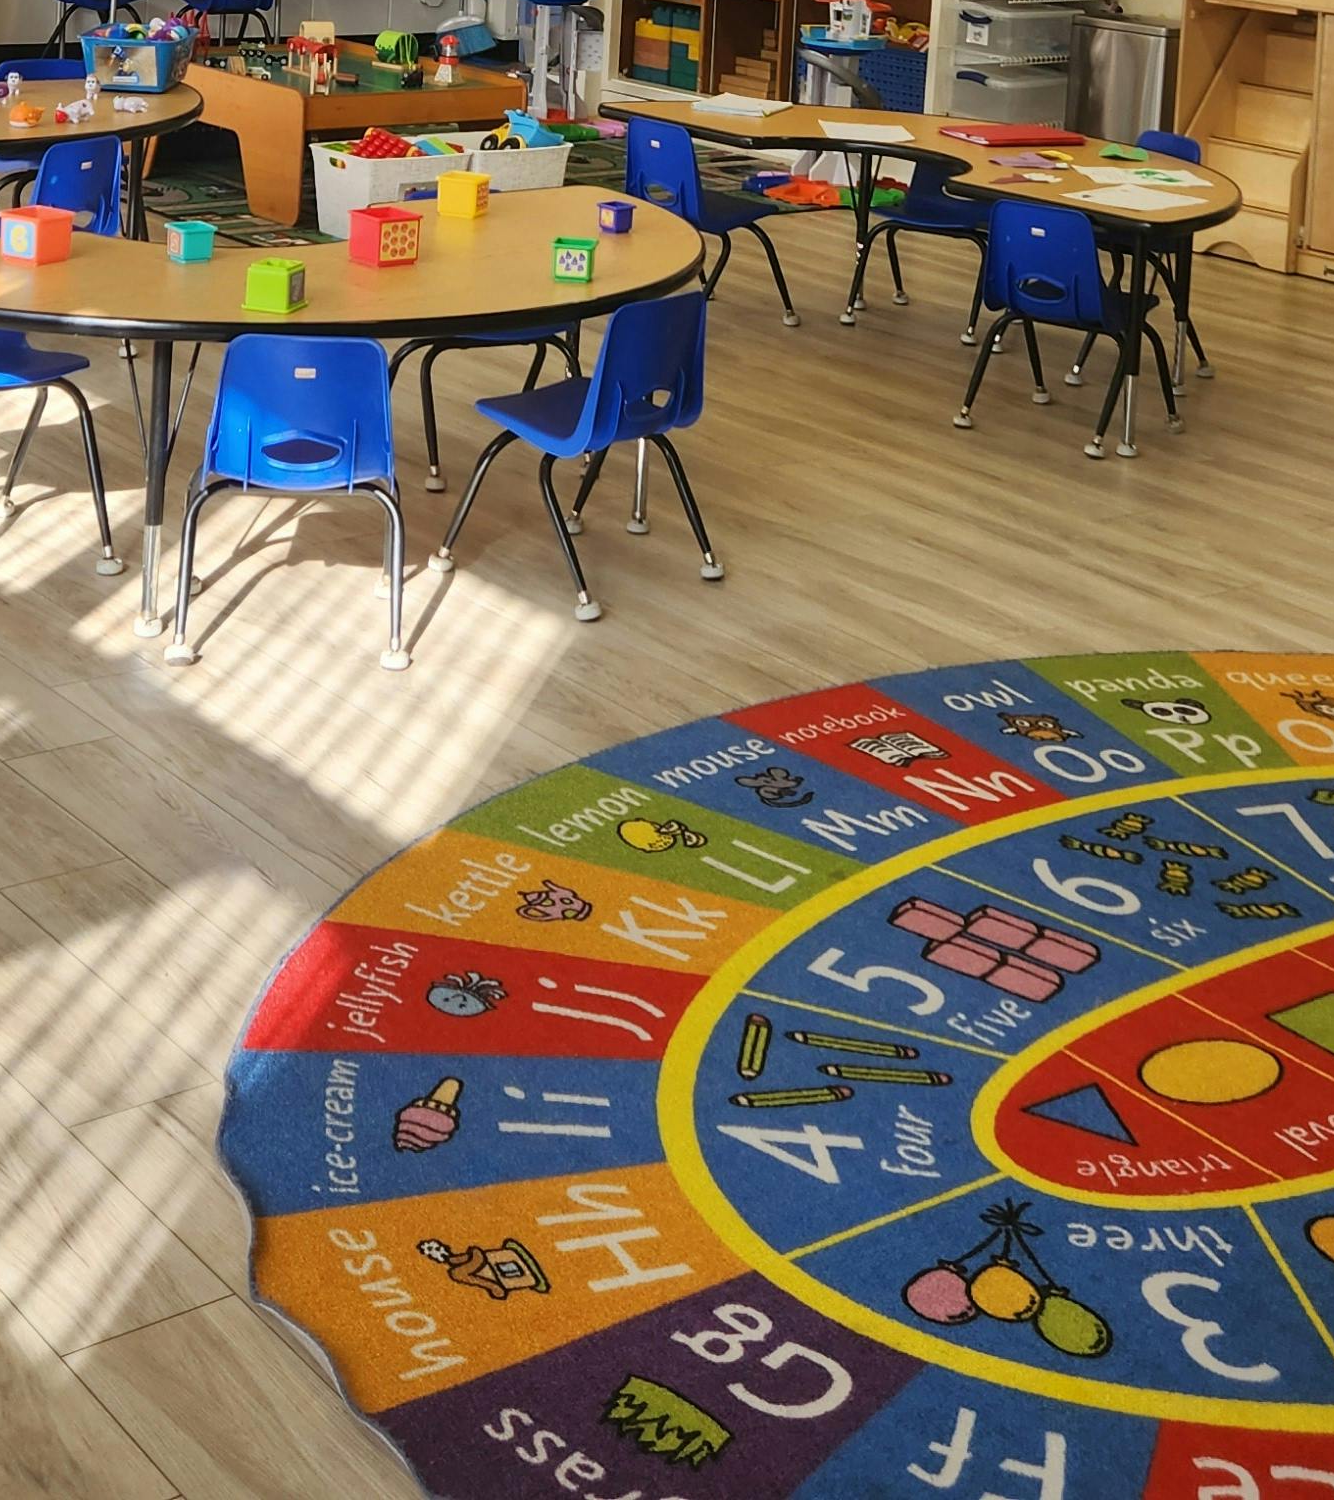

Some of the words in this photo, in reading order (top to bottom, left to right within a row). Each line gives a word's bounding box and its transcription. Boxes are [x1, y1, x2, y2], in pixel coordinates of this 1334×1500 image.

[942, 680, 1032, 714] owl
[1066, 667, 1204, 699] panda
[777, 704, 906, 745] notebook
[1145, 728, 1263, 770] Pp
[652, 733, 778, 789] mouse
[1034, 744, 1146, 786] Oo
[516, 784, 653, 848] lemon
[904, 768, 1037, 815] Nn
[800, 802, 930, 853] Mm
[404, 849, 534, 930] kettle
[699, 837, 813, 898] Ll
[1033, 856, 1142, 916] 6
[597, 889, 730, 964] Kk
[1151, 914, 1209, 950] six
[325, 940, 420, 1044] jellyfish
[530, 977, 666, 1043] Jj
[807, 946, 948, 1019] 5
[948, 997, 1033, 1047] five
[309, 1059, 361, 1194] ice-cream
[497, 1086, 612, 1138] Ii
[880, 1102, 933, 1179] four
[715, 1121, 866, 1185] 4
[1075, 1152, 1235, 1187] triangle
[535, 1182, 695, 1293] Hh
[1067, 1221, 1235, 1268] three
[329, 1228, 467, 1382] house
[1139, 1270, 1281, 1384] 3
[671, 1303, 853, 1419] Gg
